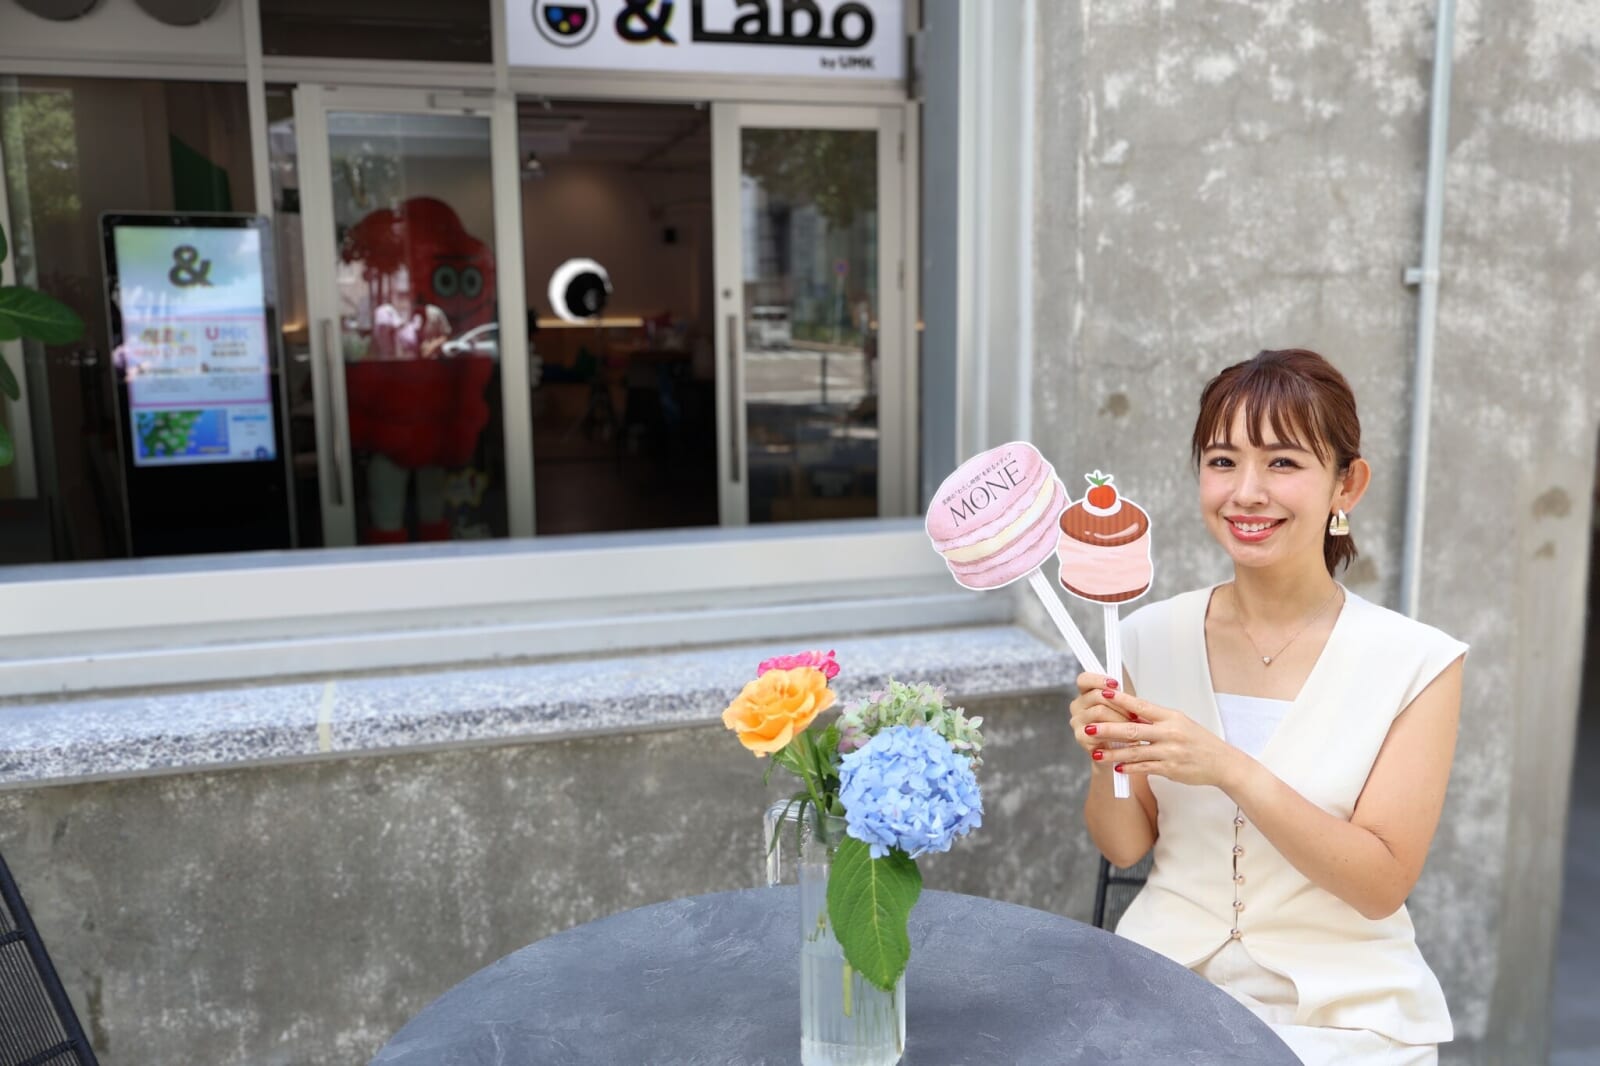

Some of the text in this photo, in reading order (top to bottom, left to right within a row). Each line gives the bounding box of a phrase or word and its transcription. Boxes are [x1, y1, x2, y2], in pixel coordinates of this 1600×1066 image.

[615, 0, 875, 48] & Labo
[839, 55, 875, 70] UMK
[168, 244, 213, 287] &
[950, 460, 1027, 527] MONE
